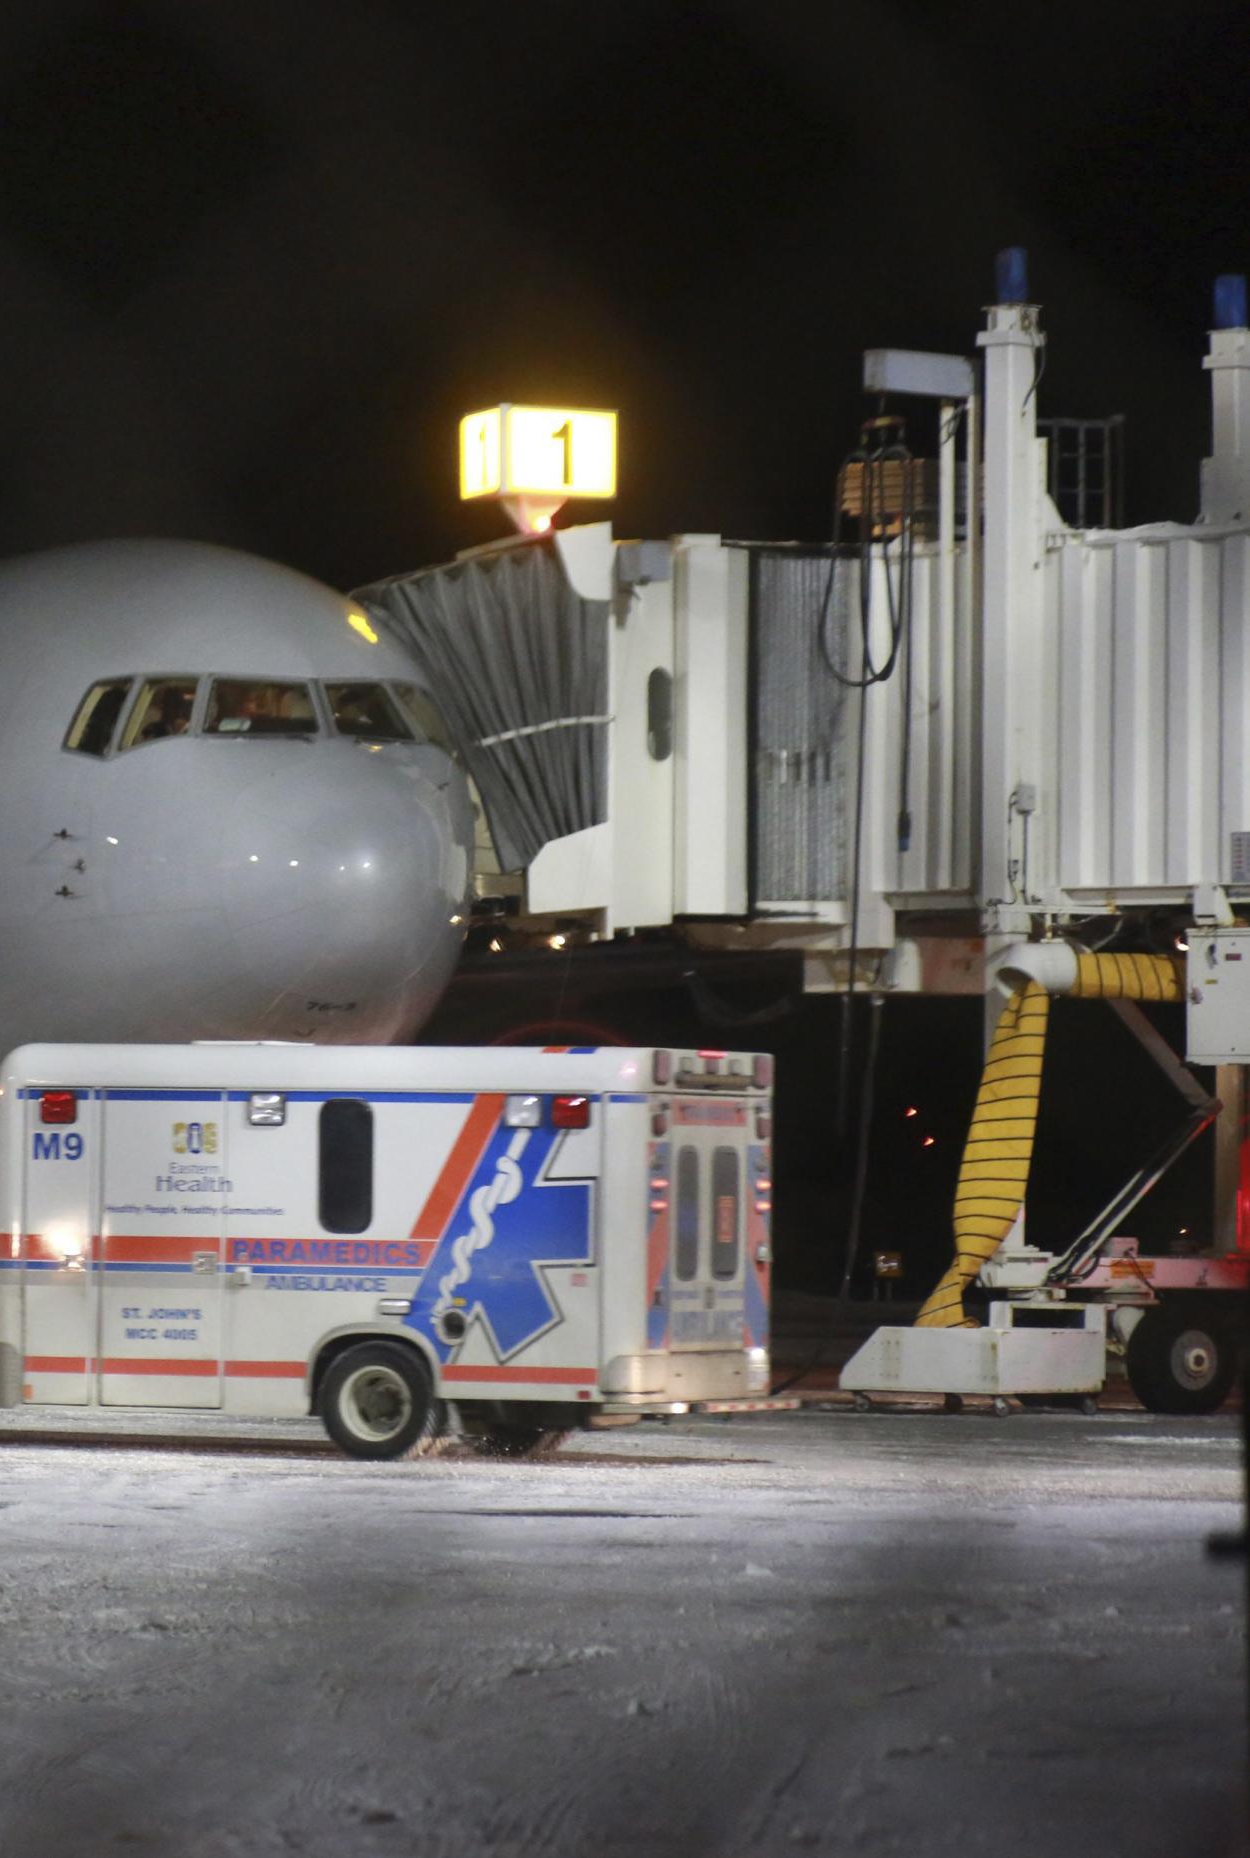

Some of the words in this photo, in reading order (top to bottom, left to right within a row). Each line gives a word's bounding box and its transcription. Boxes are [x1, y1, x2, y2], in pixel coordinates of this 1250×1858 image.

[551, 418, 573, 486] 1
[32, 1132, 84, 1161] M9
[169, 1161, 219, 1174] Eastern
[156, 1175, 233, 1192] Health
[233, 1240, 420, 1264] PARAMEDICS
[266, 1275, 387, 1293] AMBULANCE
[121, 1307, 144, 1319] ST.
[148, 1308, 202, 1320] JOHN'S
